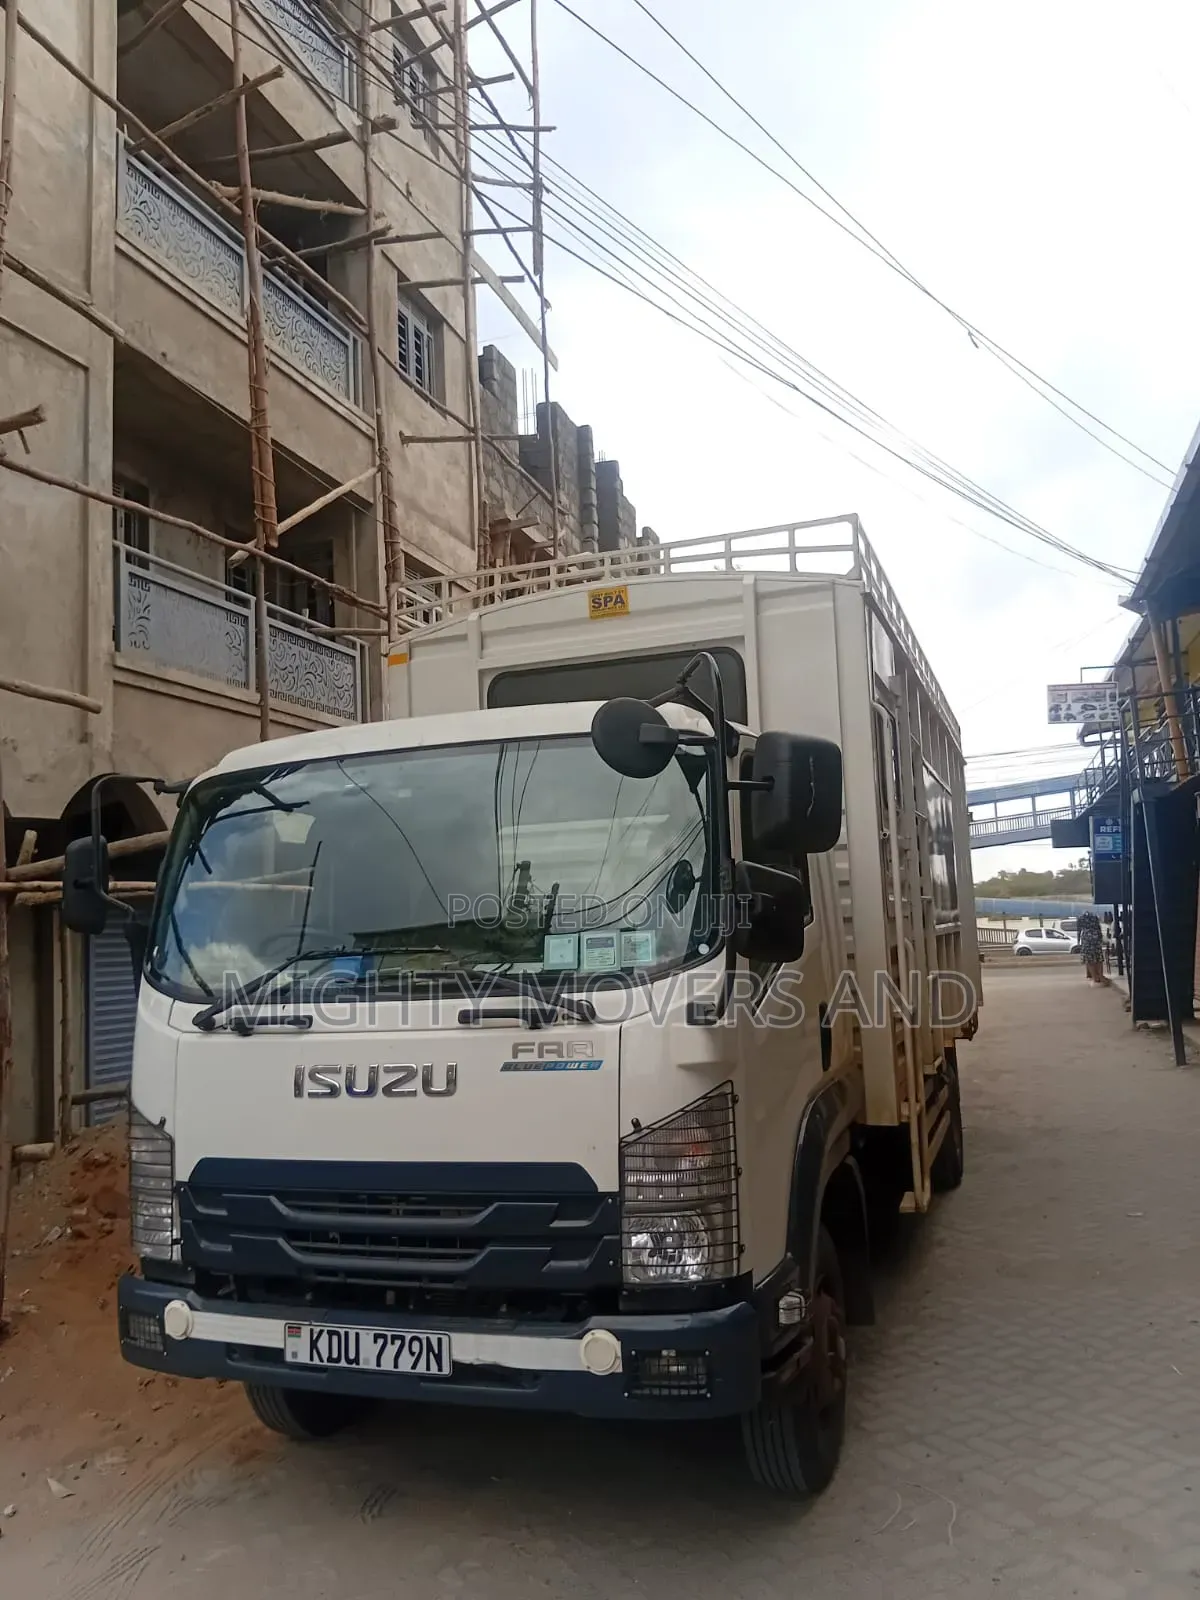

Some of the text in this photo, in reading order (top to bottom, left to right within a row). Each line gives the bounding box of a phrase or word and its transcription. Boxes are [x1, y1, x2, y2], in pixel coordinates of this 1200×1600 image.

[592, 594, 625, 609] SPA
[294, 1062, 458, 1099] ISUZU
[309, 1327, 443, 1373] KDU 779N
